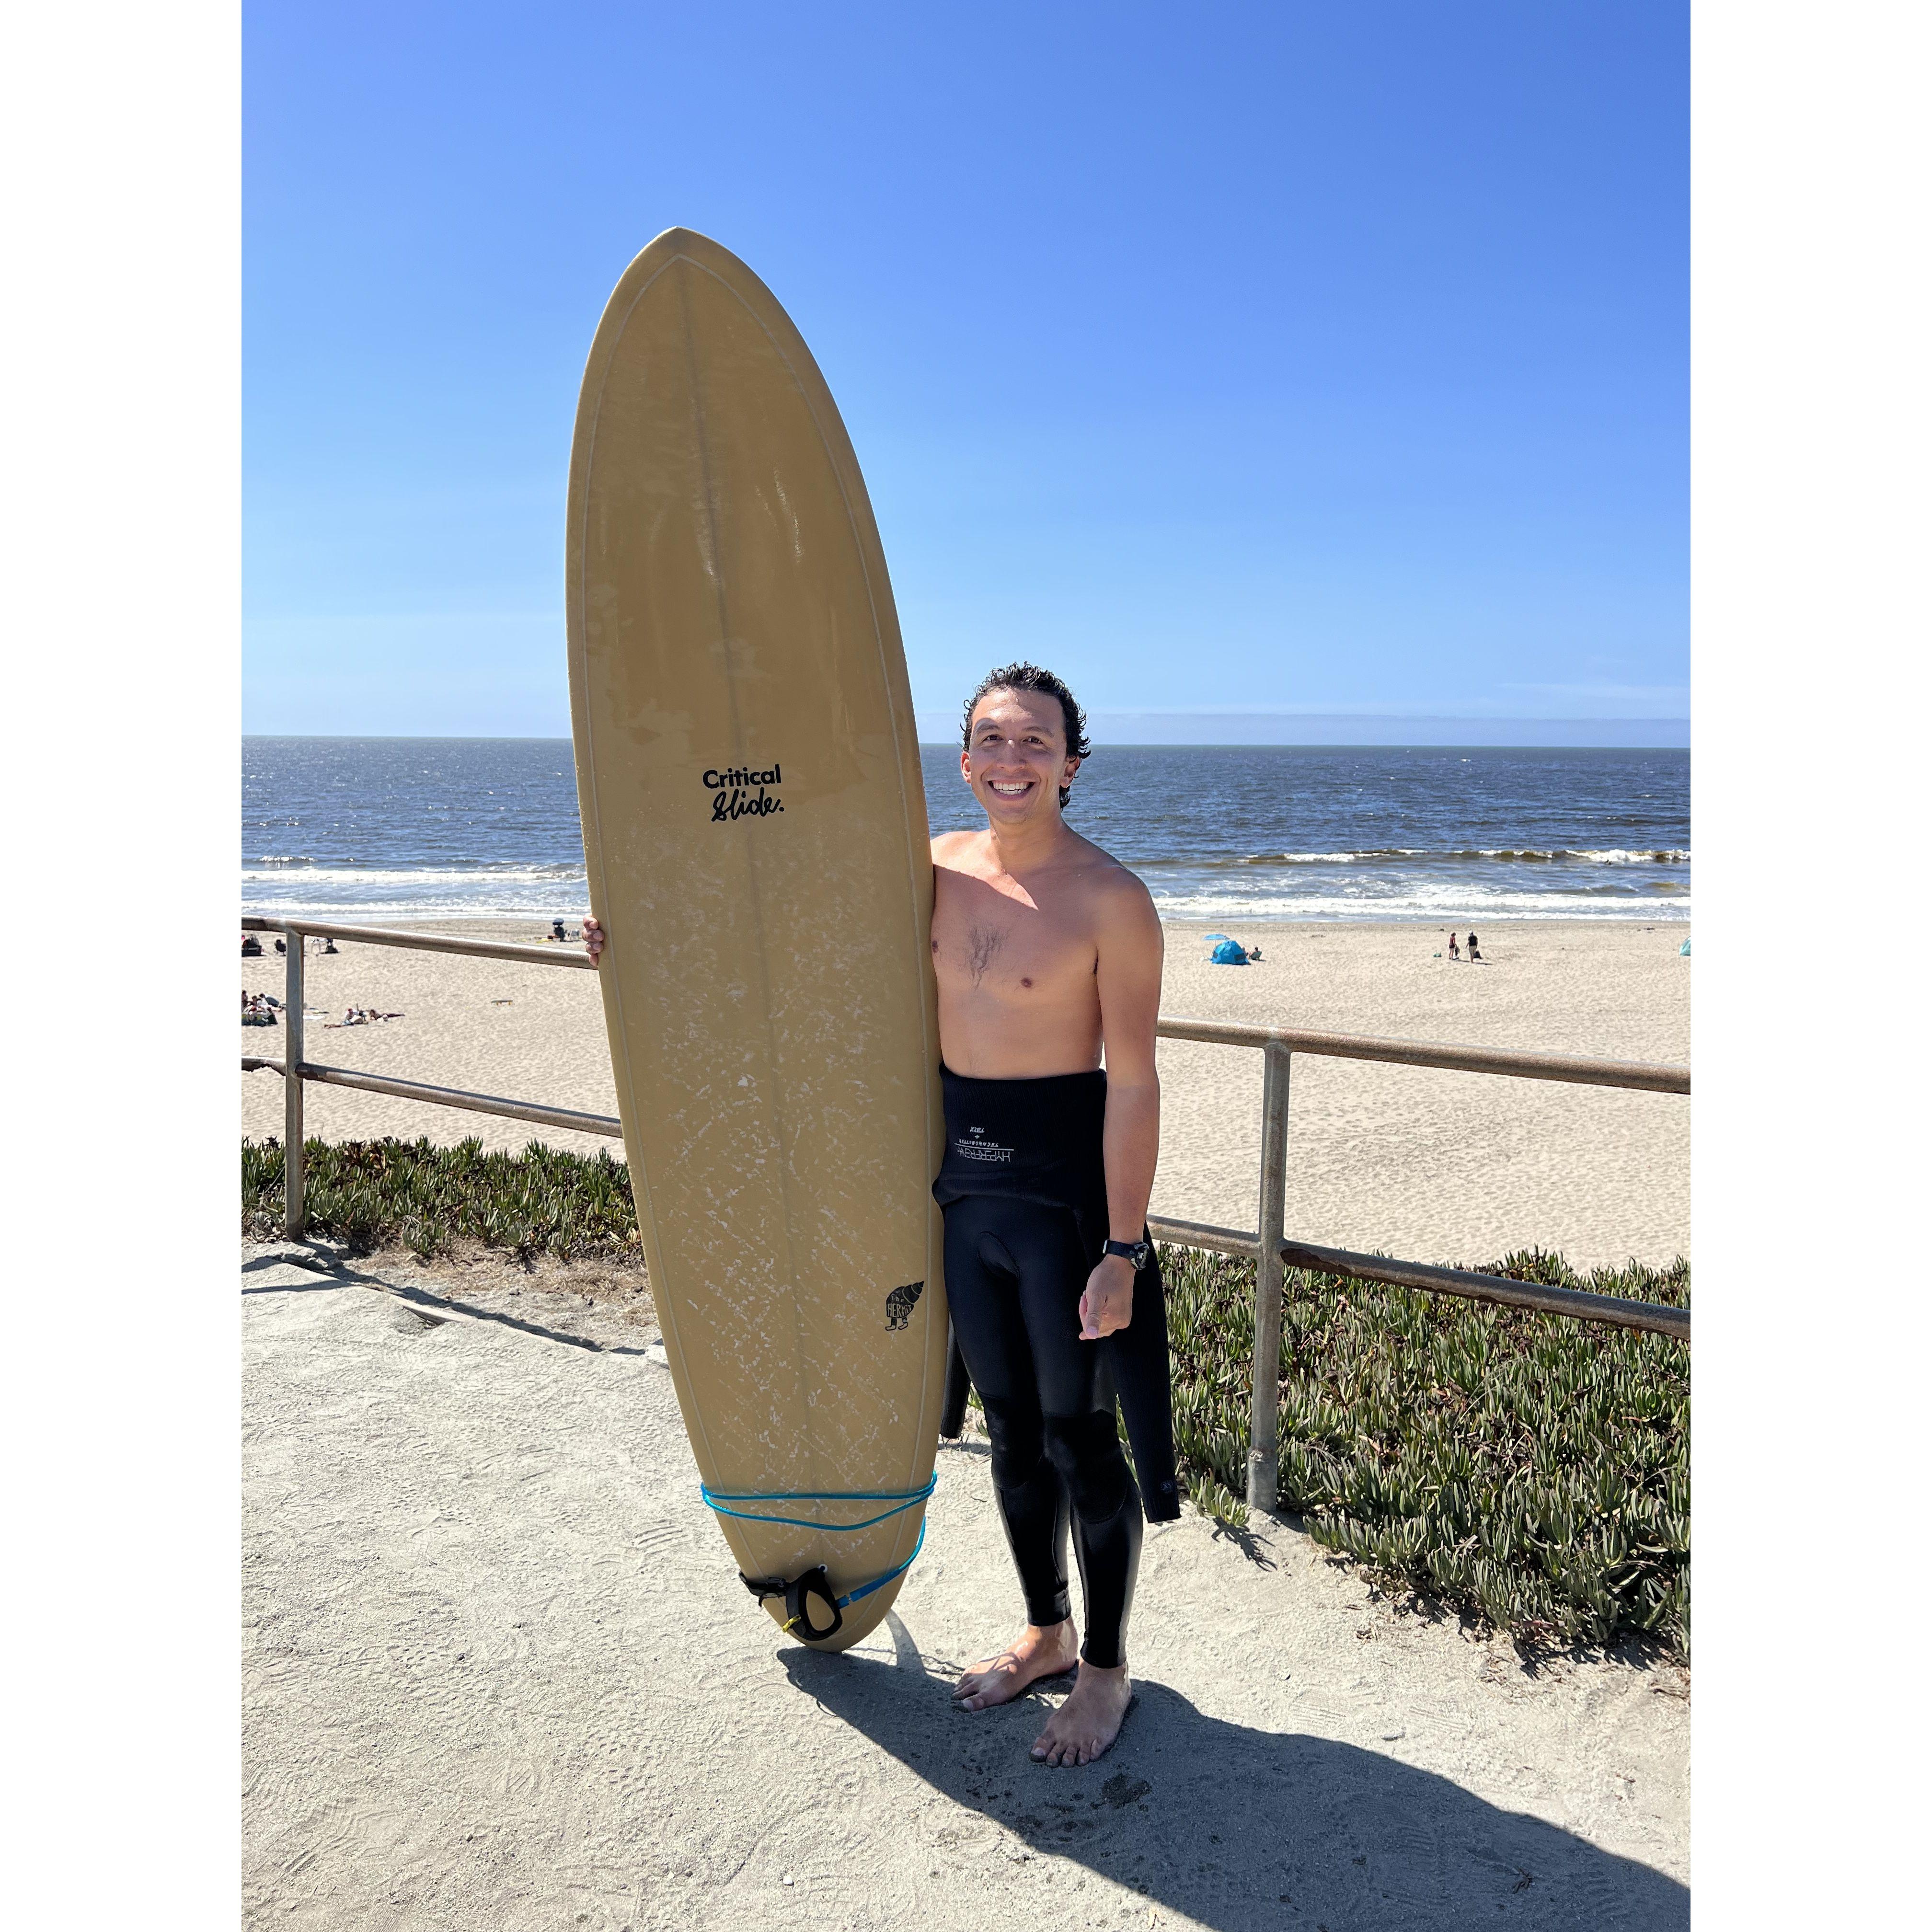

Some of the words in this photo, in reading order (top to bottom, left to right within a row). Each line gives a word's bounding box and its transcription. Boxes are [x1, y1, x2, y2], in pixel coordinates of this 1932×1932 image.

[702, 764, 782, 789] Critical
[711, 787, 784, 822] Slide.
[887, 1303, 912, 1318] HERMIT
